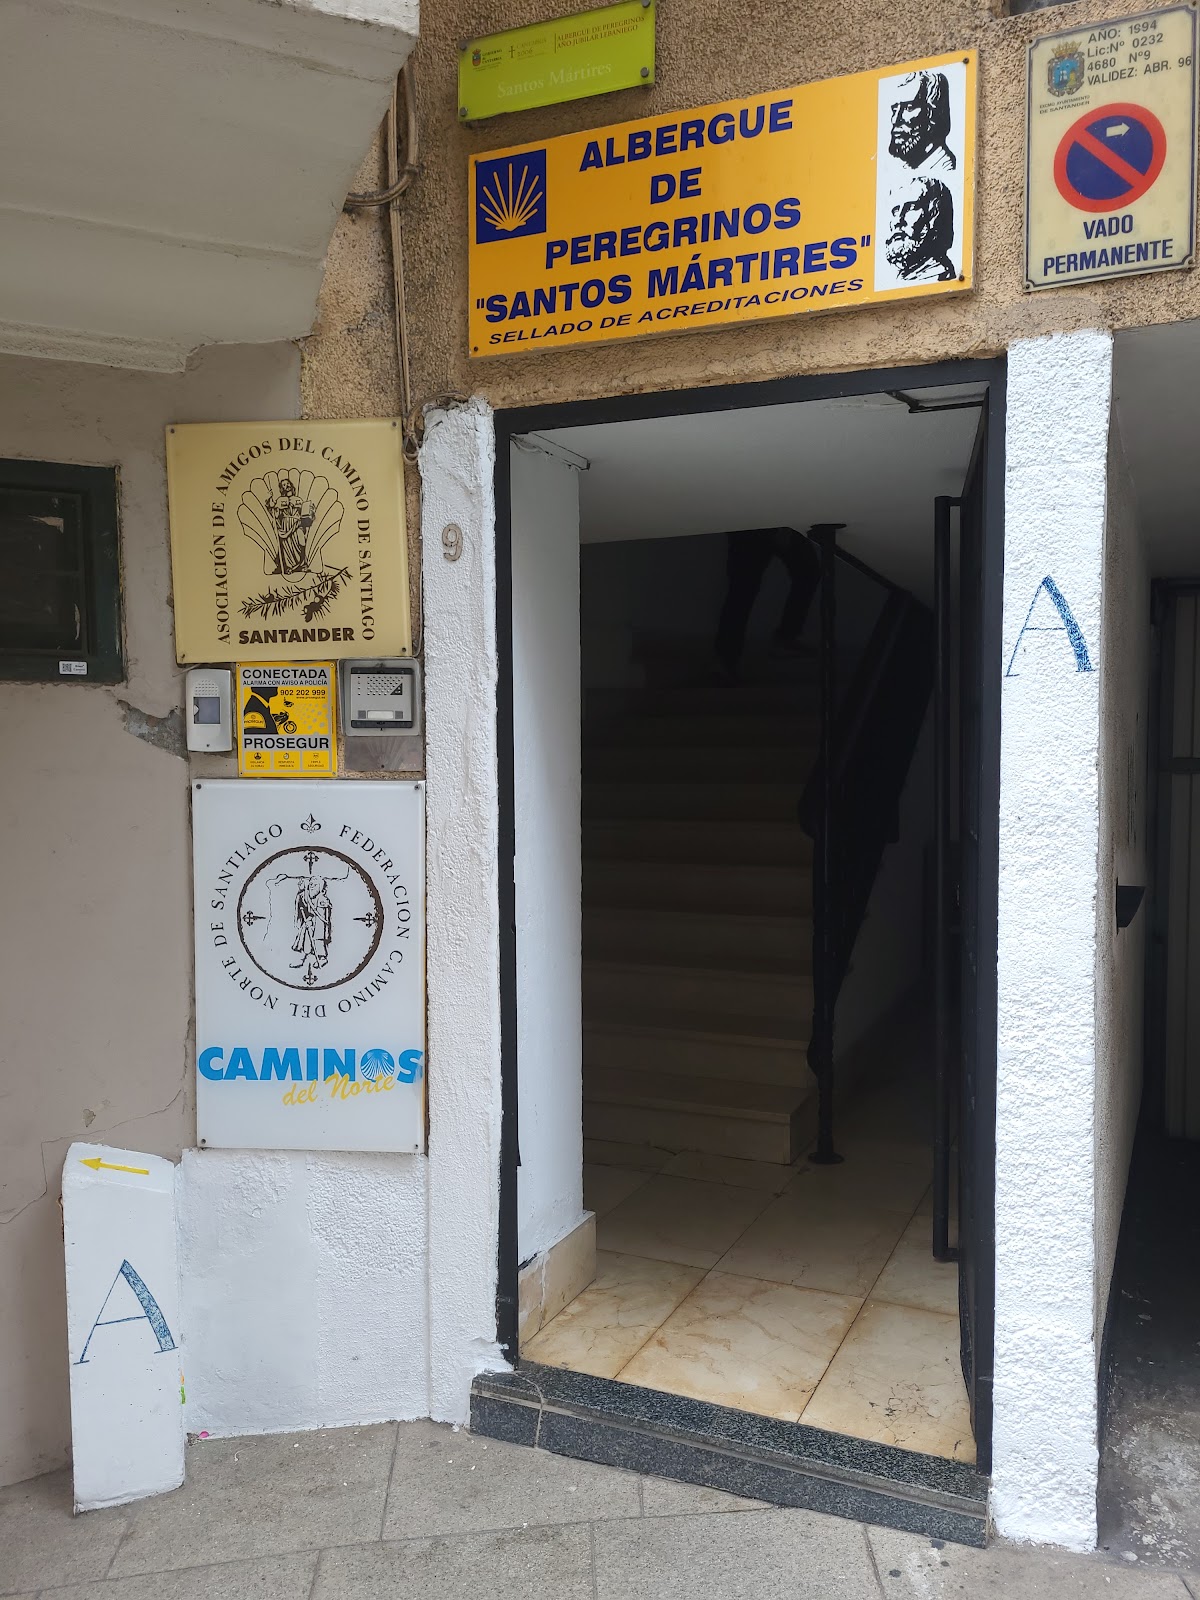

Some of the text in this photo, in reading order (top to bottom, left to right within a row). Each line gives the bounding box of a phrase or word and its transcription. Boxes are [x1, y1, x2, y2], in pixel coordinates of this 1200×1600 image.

[557, 16, 645, 41] ALBERGUE DE PEREGRINOS
[557, 39, 572, 49] AÑO
[572, 34, 599, 47] JUBILAR
[1088, 26, 1121, 44] AÑO:
[1132, 32, 1164, 49] 0232
[497, 62, 613, 98] Santos Mártires
[1087, 57, 1117, 72] 4680
[1087, 55, 1192, 86] VALIDEZ: ABR. 96
[578, 99, 794, 173] ALBERGUE
[649, 166, 703, 205] DE
[545, 197, 802, 270] PEREGRINOS
[1083, 214, 1134, 240] VADO
[1043, 238, 1174, 277] PERMANENTE
[476, 234, 872, 324] "SANTOS MÁRTIRES"
[488, 277, 865, 346] SELLADO DE ACREDITACIONES
[209, 437, 376, 645] ASOCIACIÓN DE AMIGOS DEL CAMINO DE SANTIAGO
[441, 523, 464, 562] 9
[238, 627, 356, 645] SANTANDER
[1003, 574, 1096, 677] A
[242, 669, 328, 679] CONECTADA
[244, 737, 330, 749] PROSEGUR
[210, 824, 411, 1018] FEDERACION CAMINO DEL NORTE DE SANTIAGO
[198, 1046, 424, 1084] CAMINOS
[282, 1072, 396, 1106] del Norte
[73, 1258, 179, 1366] A
